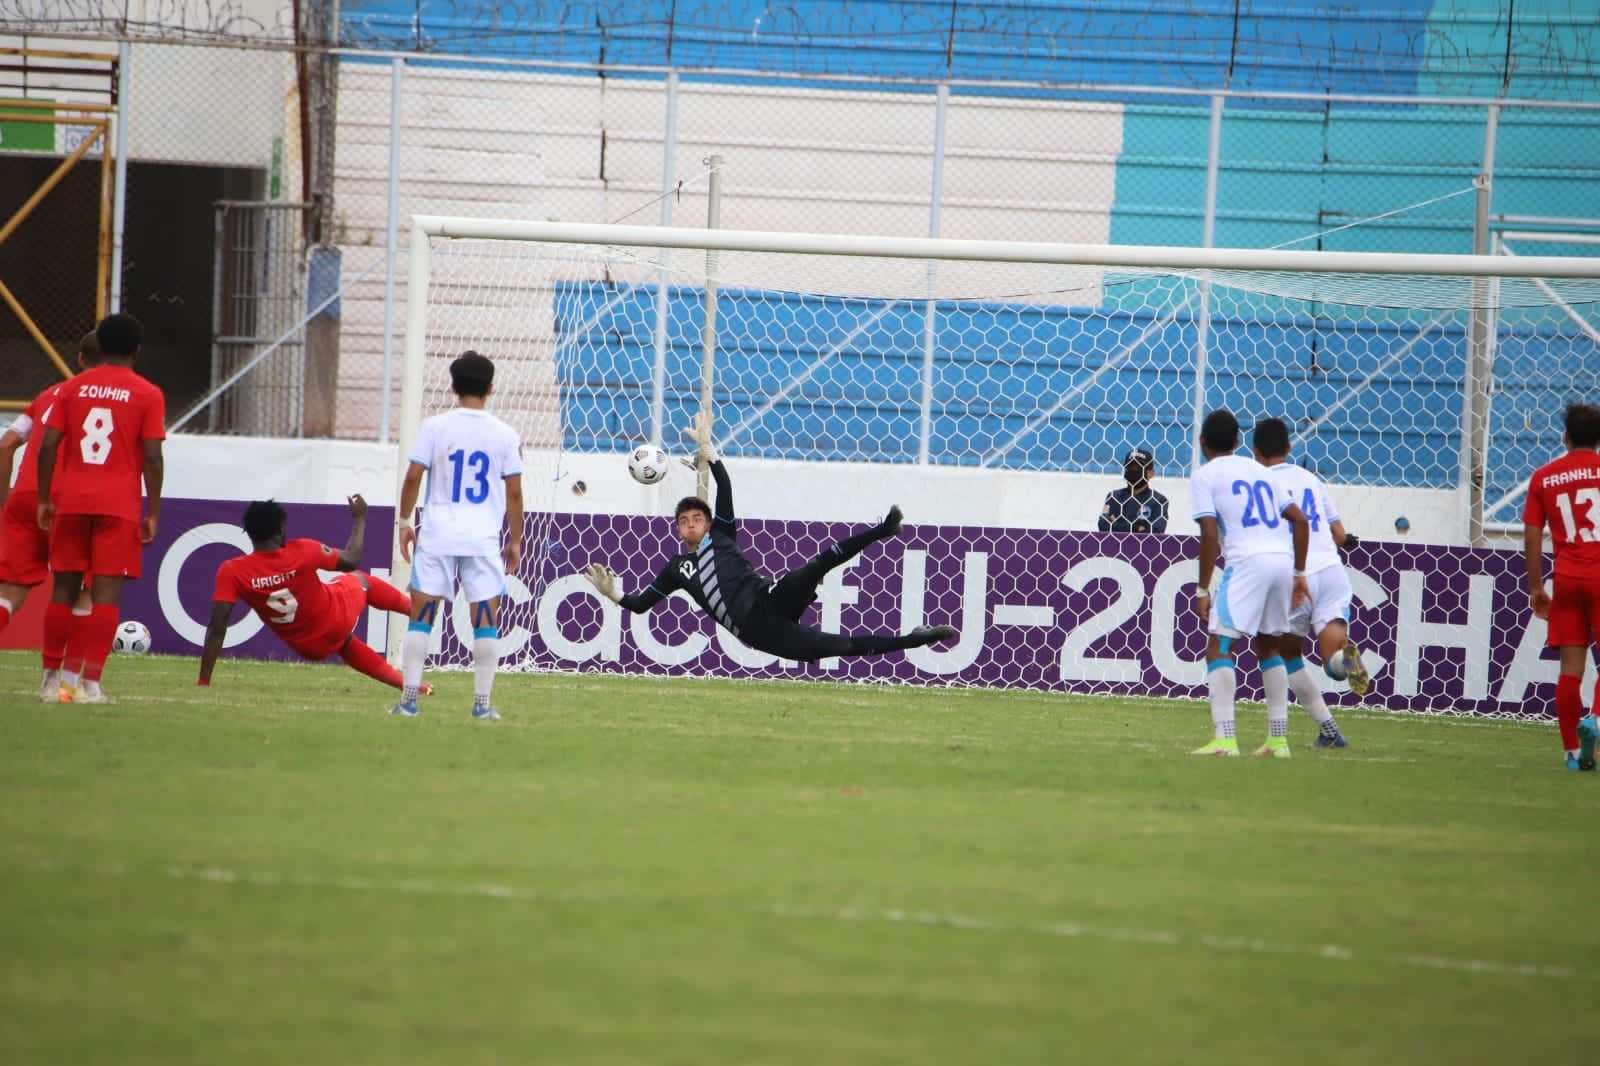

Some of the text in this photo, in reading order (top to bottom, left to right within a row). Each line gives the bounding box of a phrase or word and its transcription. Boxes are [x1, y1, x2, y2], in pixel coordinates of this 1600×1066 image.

[78, 385, 131, 403] ZOUHIR
[80, 407, 114, 465] 8
[448, 448, 490, 504] 13
[1232, 479, 1280, 529] 20
[1556, 488, 1600, 543] 13
[251, 569, 297, 589] WRIGHT
[679, 560, 698, 580] 12
[266, 588, 299, 624] 9
[902, 549, 1227, 687] U-20
